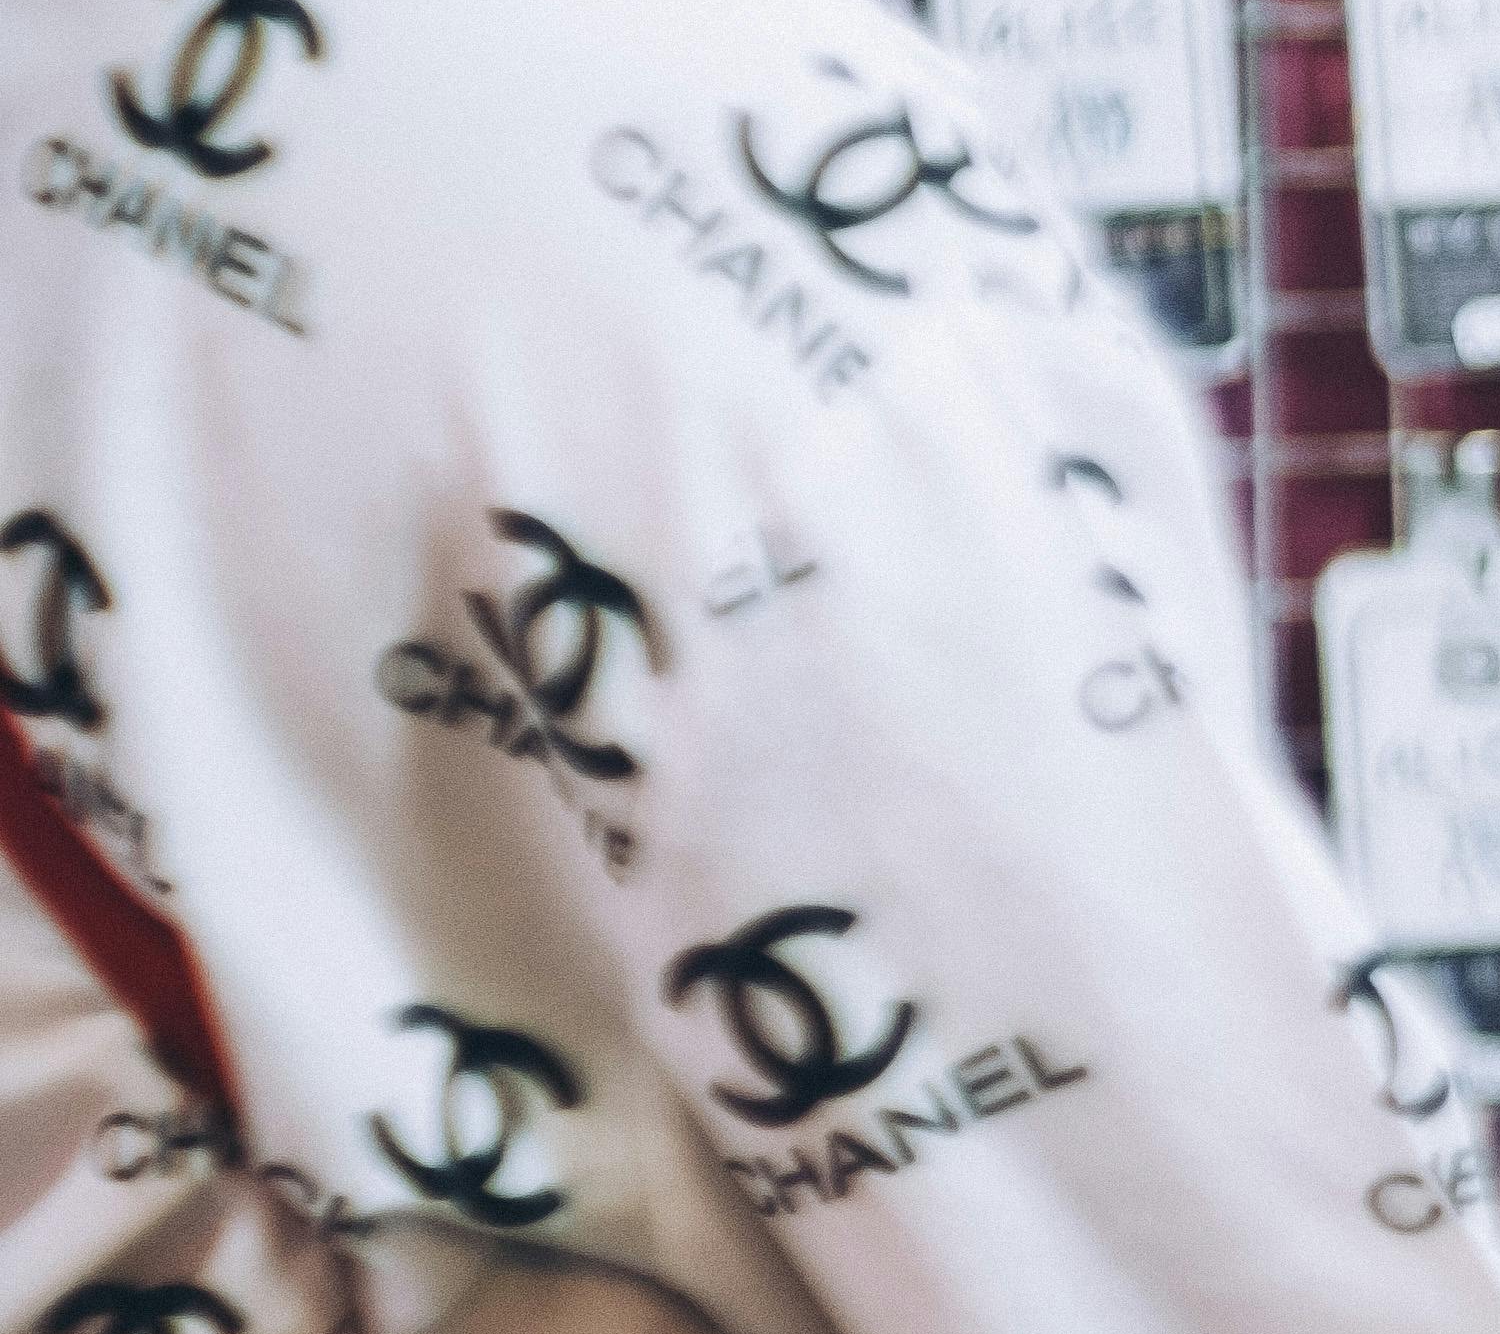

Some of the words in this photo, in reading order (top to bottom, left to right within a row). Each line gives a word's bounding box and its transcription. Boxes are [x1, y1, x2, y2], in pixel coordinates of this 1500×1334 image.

[23, 135, 311, 335] CHANEL
[592, 125, 872, 405] CHANE
[725, 1035, 1090, 1217] CHANEL
